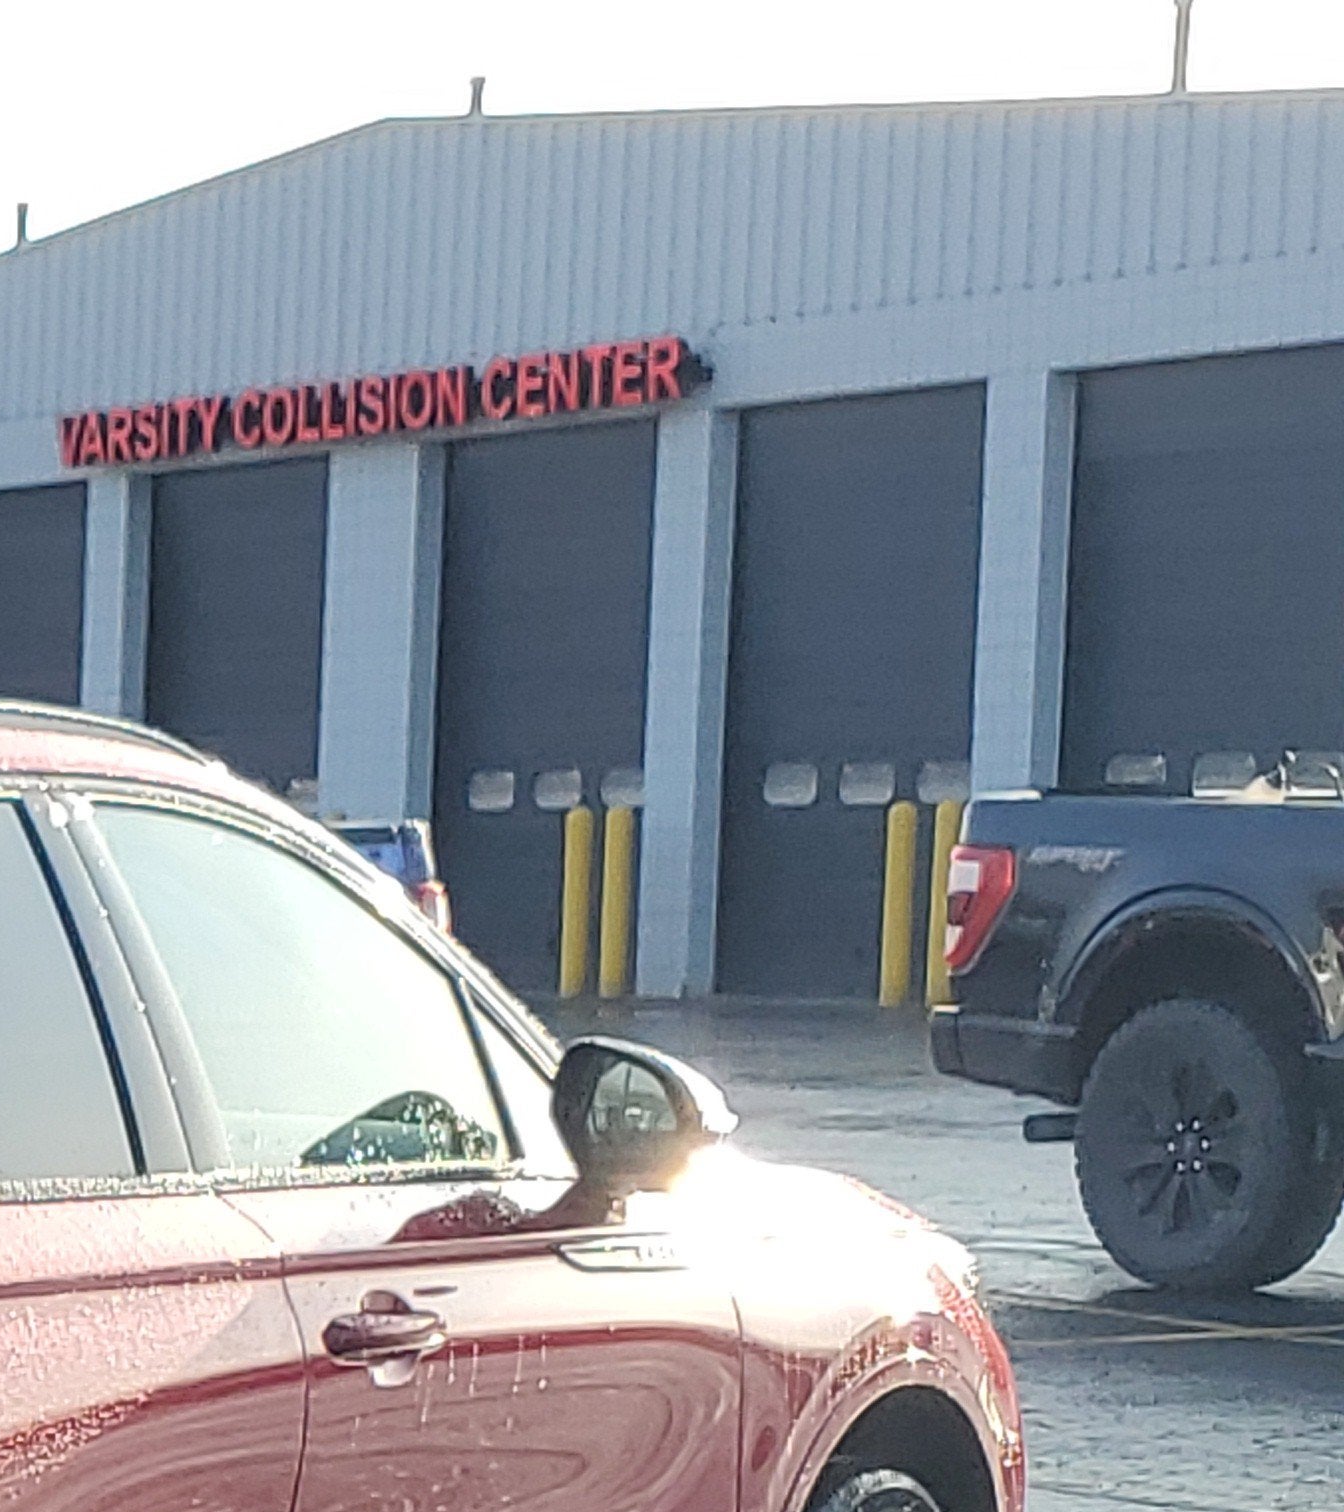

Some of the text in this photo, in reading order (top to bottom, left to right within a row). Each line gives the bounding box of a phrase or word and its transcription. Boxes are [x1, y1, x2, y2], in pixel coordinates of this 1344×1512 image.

[58, 336, 684, 468] VARSITY COLLISION CENTER
